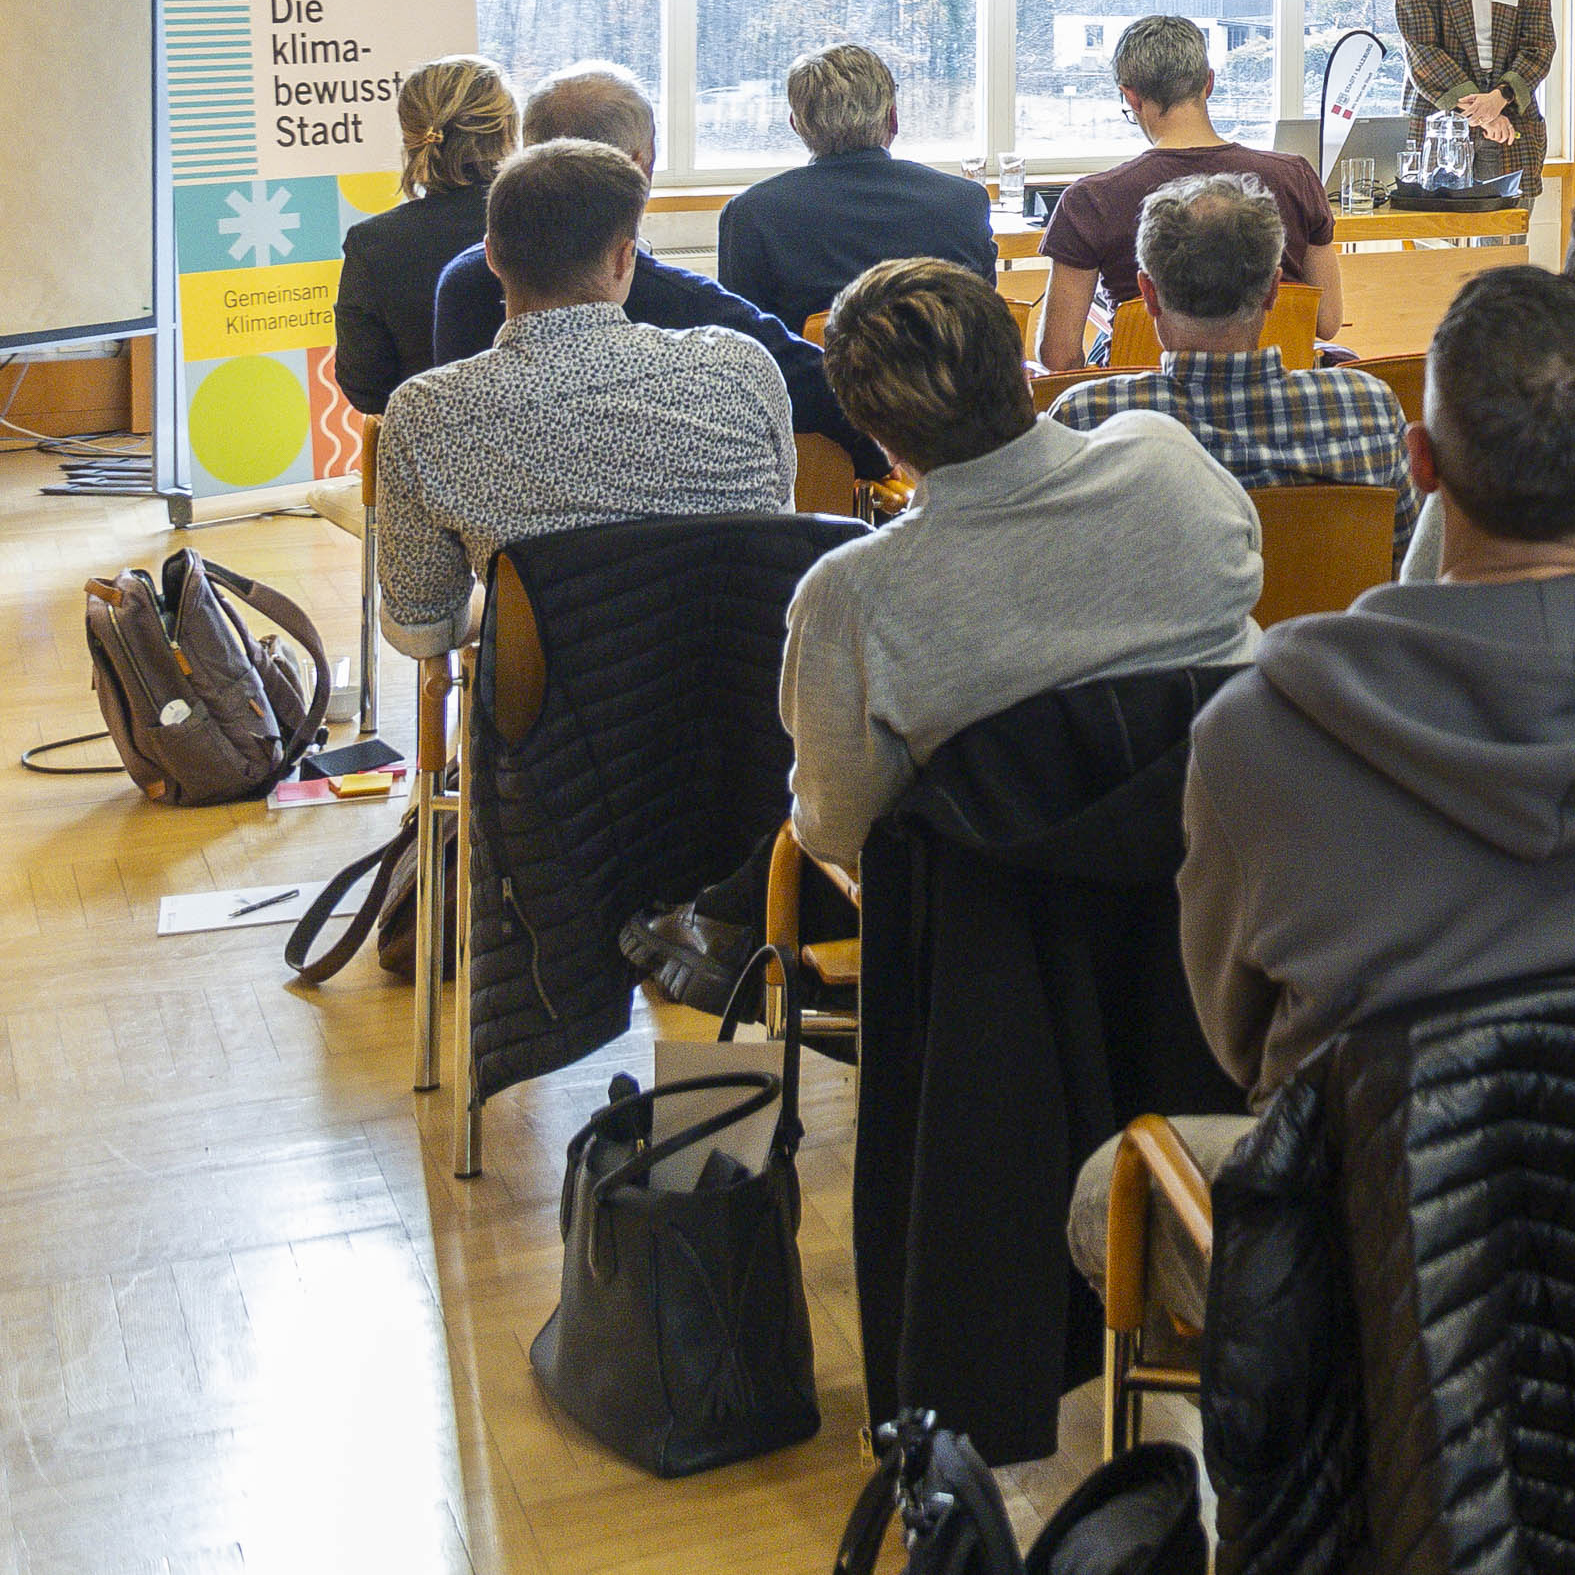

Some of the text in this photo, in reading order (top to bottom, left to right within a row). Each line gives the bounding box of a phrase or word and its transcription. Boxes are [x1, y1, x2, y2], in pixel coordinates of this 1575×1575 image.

[272, 34, 371, 64] klima-
[274, 71, 403, 106] bewusst
[276, 113, 363, 147] Stadt
[223, 283, 328, 309] Gemeinsam
[226, 308, 333, 335] Klimaneutra
